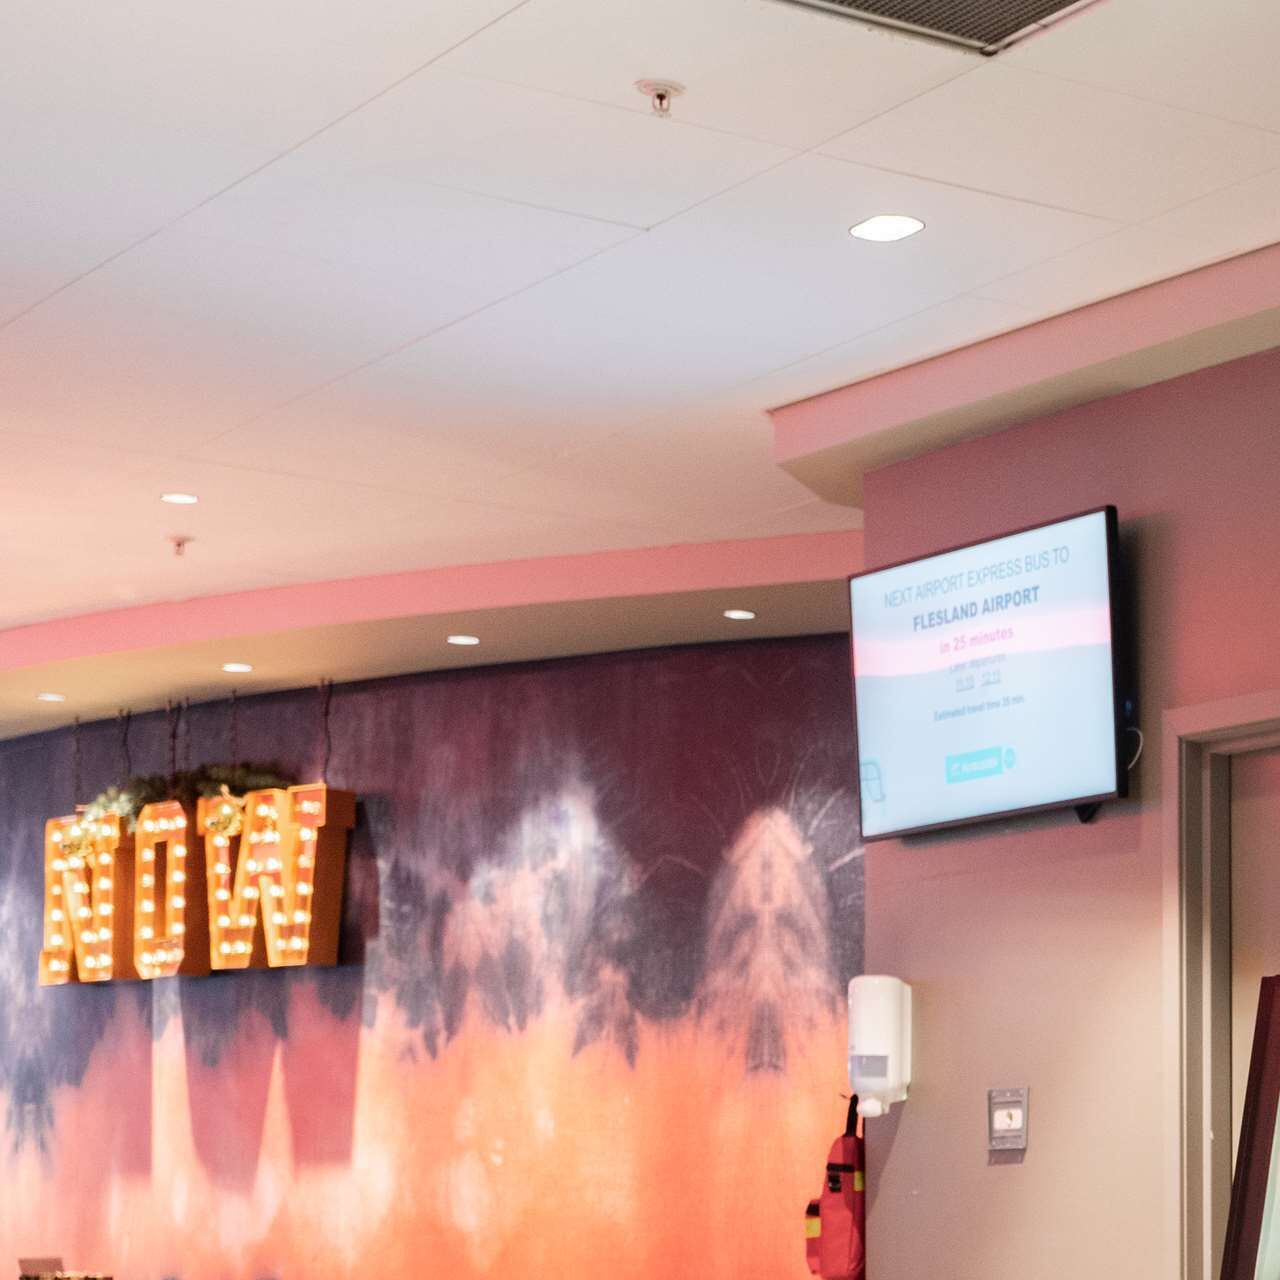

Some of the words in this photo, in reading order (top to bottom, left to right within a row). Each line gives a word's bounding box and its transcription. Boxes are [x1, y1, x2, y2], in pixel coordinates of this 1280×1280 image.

[884, 586, 912, 608] NEXT
[916, 573, 963, 601] AIRPORT
[967, 558, 1022, 588] EXPRESS
[1025, 551, 1051, 573] BUS
[1053, 546, 1070, 565] TO
[913, 602, 978, 632] FLESLAND
[982, 586, 1040, 615] AIRPORT
[953, 635, 967, 650] 25
[970, 627, 1014, 646] minutes
[39, 784, 326, 986] NOW
